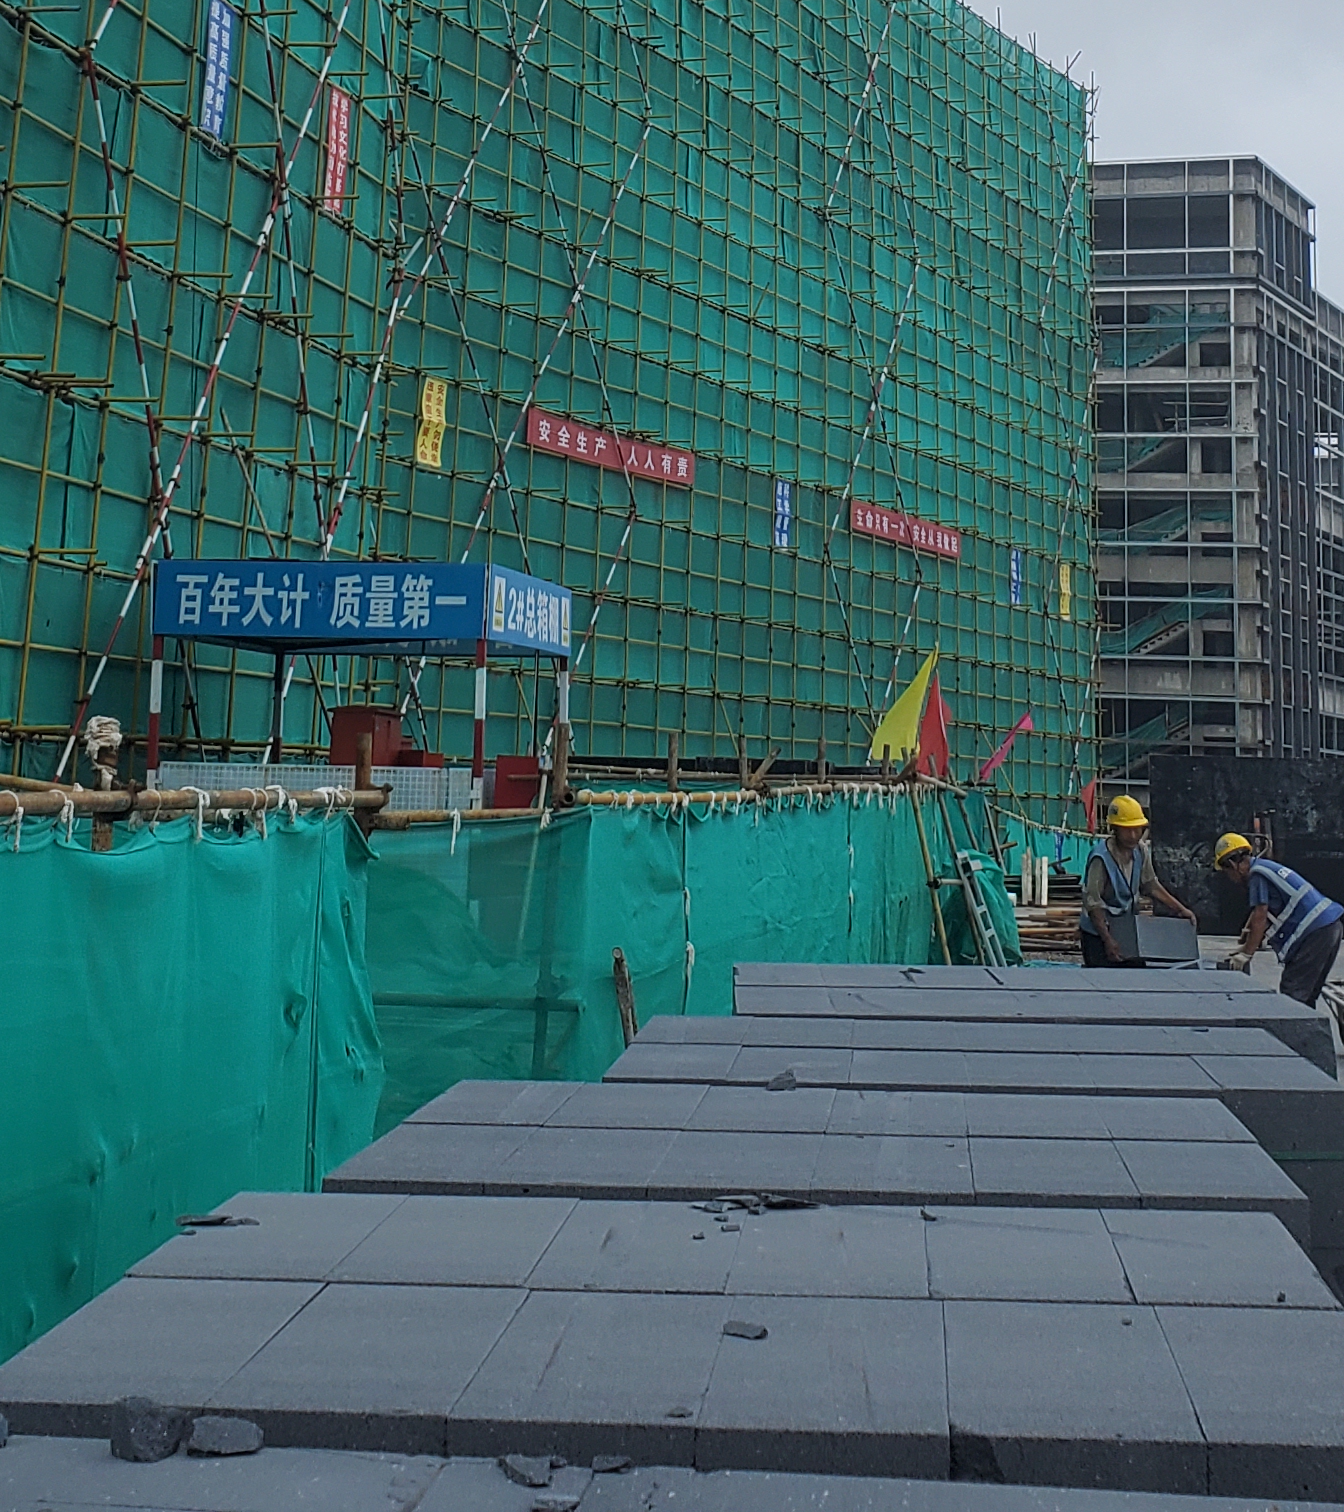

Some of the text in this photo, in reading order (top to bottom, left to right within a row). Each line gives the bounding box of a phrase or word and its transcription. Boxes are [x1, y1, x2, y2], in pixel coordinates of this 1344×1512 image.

[539, 419, 688, 478] 安全生产 人人有责
[176, 572, 467, 630] 百年大计 质量第一
